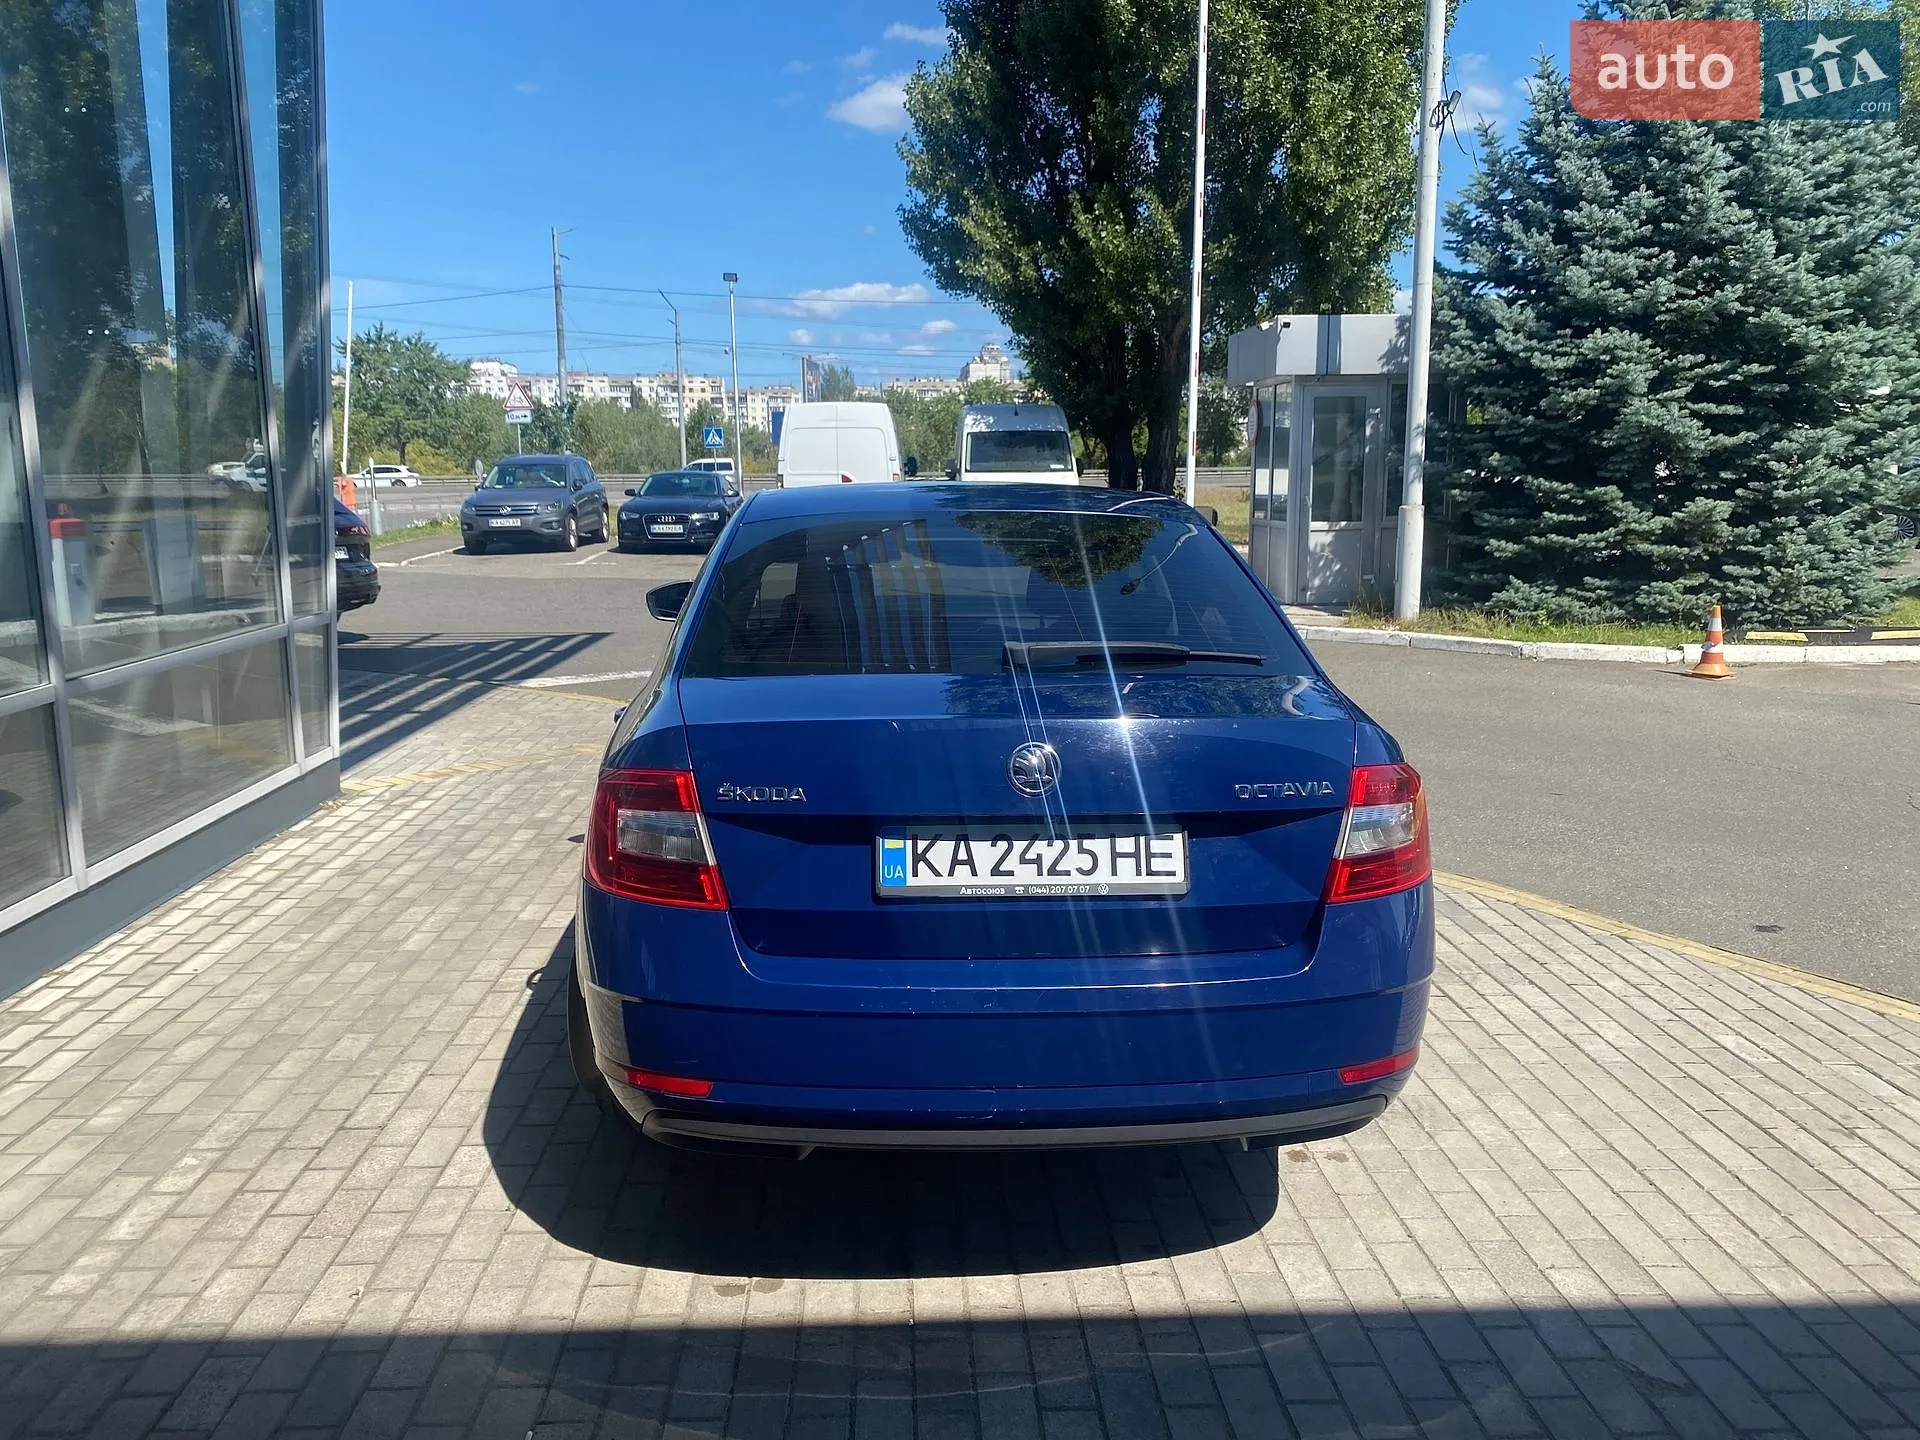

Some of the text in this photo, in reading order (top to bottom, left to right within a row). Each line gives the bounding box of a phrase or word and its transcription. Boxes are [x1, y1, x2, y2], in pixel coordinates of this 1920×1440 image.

[716, 783, 807, 802] ŠKODA
[1233, 781, 1336, 799] OCTAVIA
[911, 833, 1178, 878] KA 2425 HE
[884, 865, 905, 879] UA
[960, 886, 1005, 895] Автосоюз
[1028, 886, 1050, 895] (044)
[1051, 886, 1065, 894] 207
[1067, 886, 1078, 894] 07
